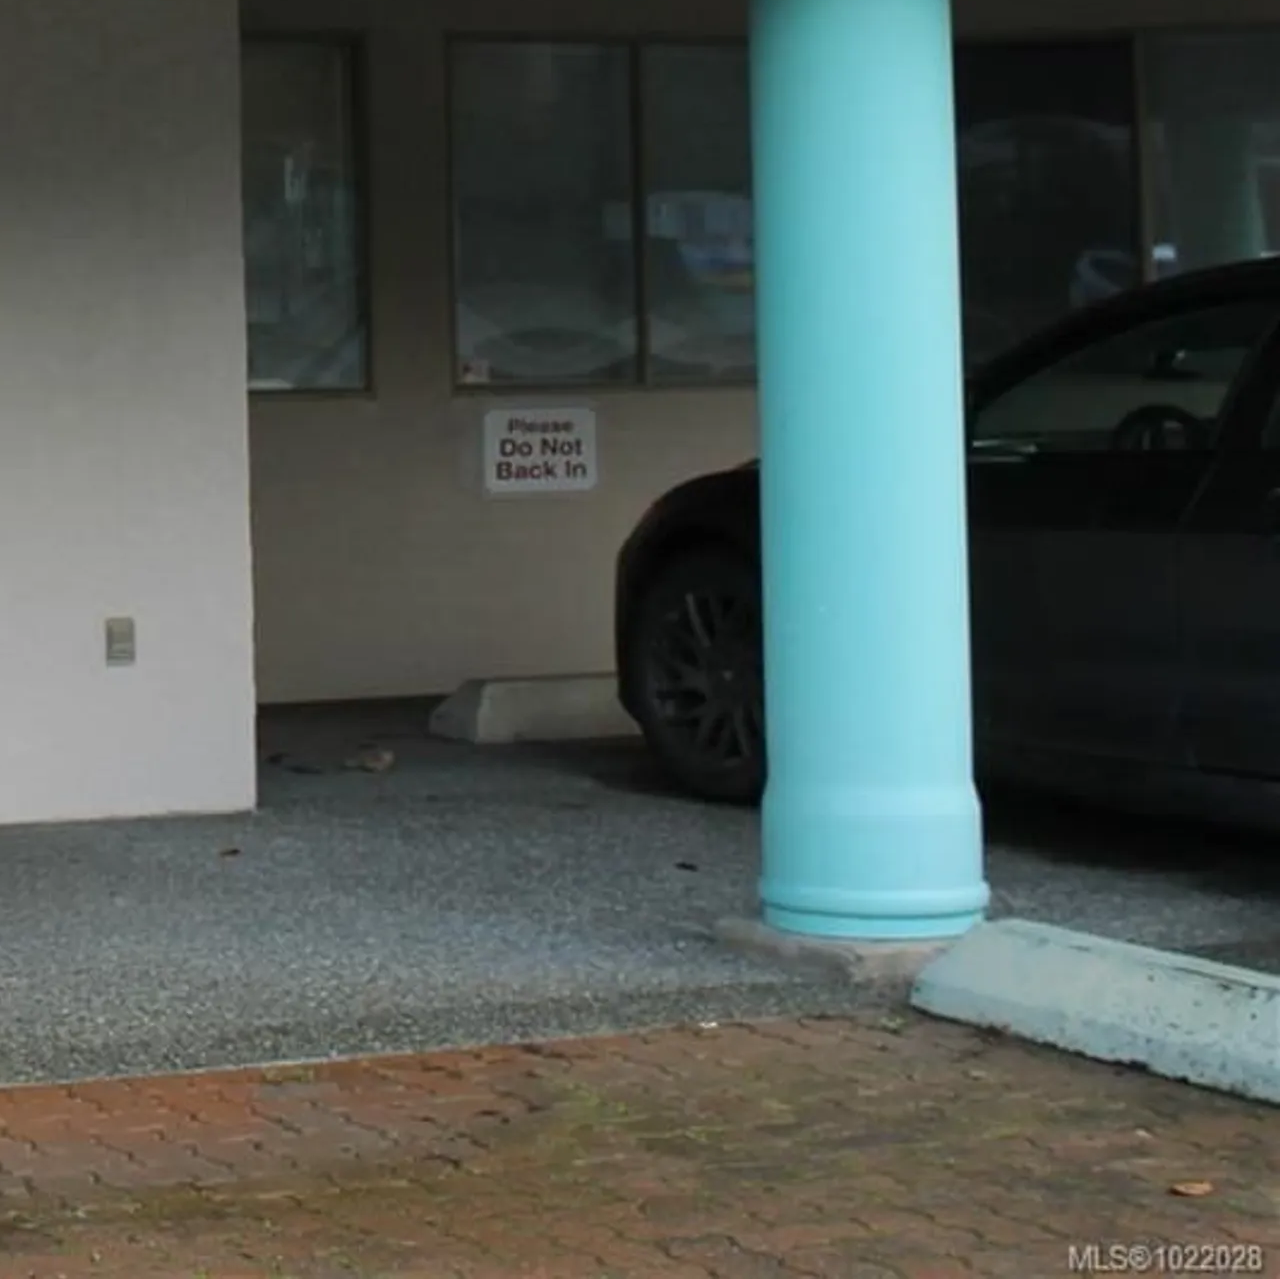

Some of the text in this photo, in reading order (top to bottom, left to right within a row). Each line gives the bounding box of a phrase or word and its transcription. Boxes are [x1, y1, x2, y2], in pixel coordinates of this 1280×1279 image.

[500, 437, 582, 457] Do Not
[496, 460, 588, 480] Back In
